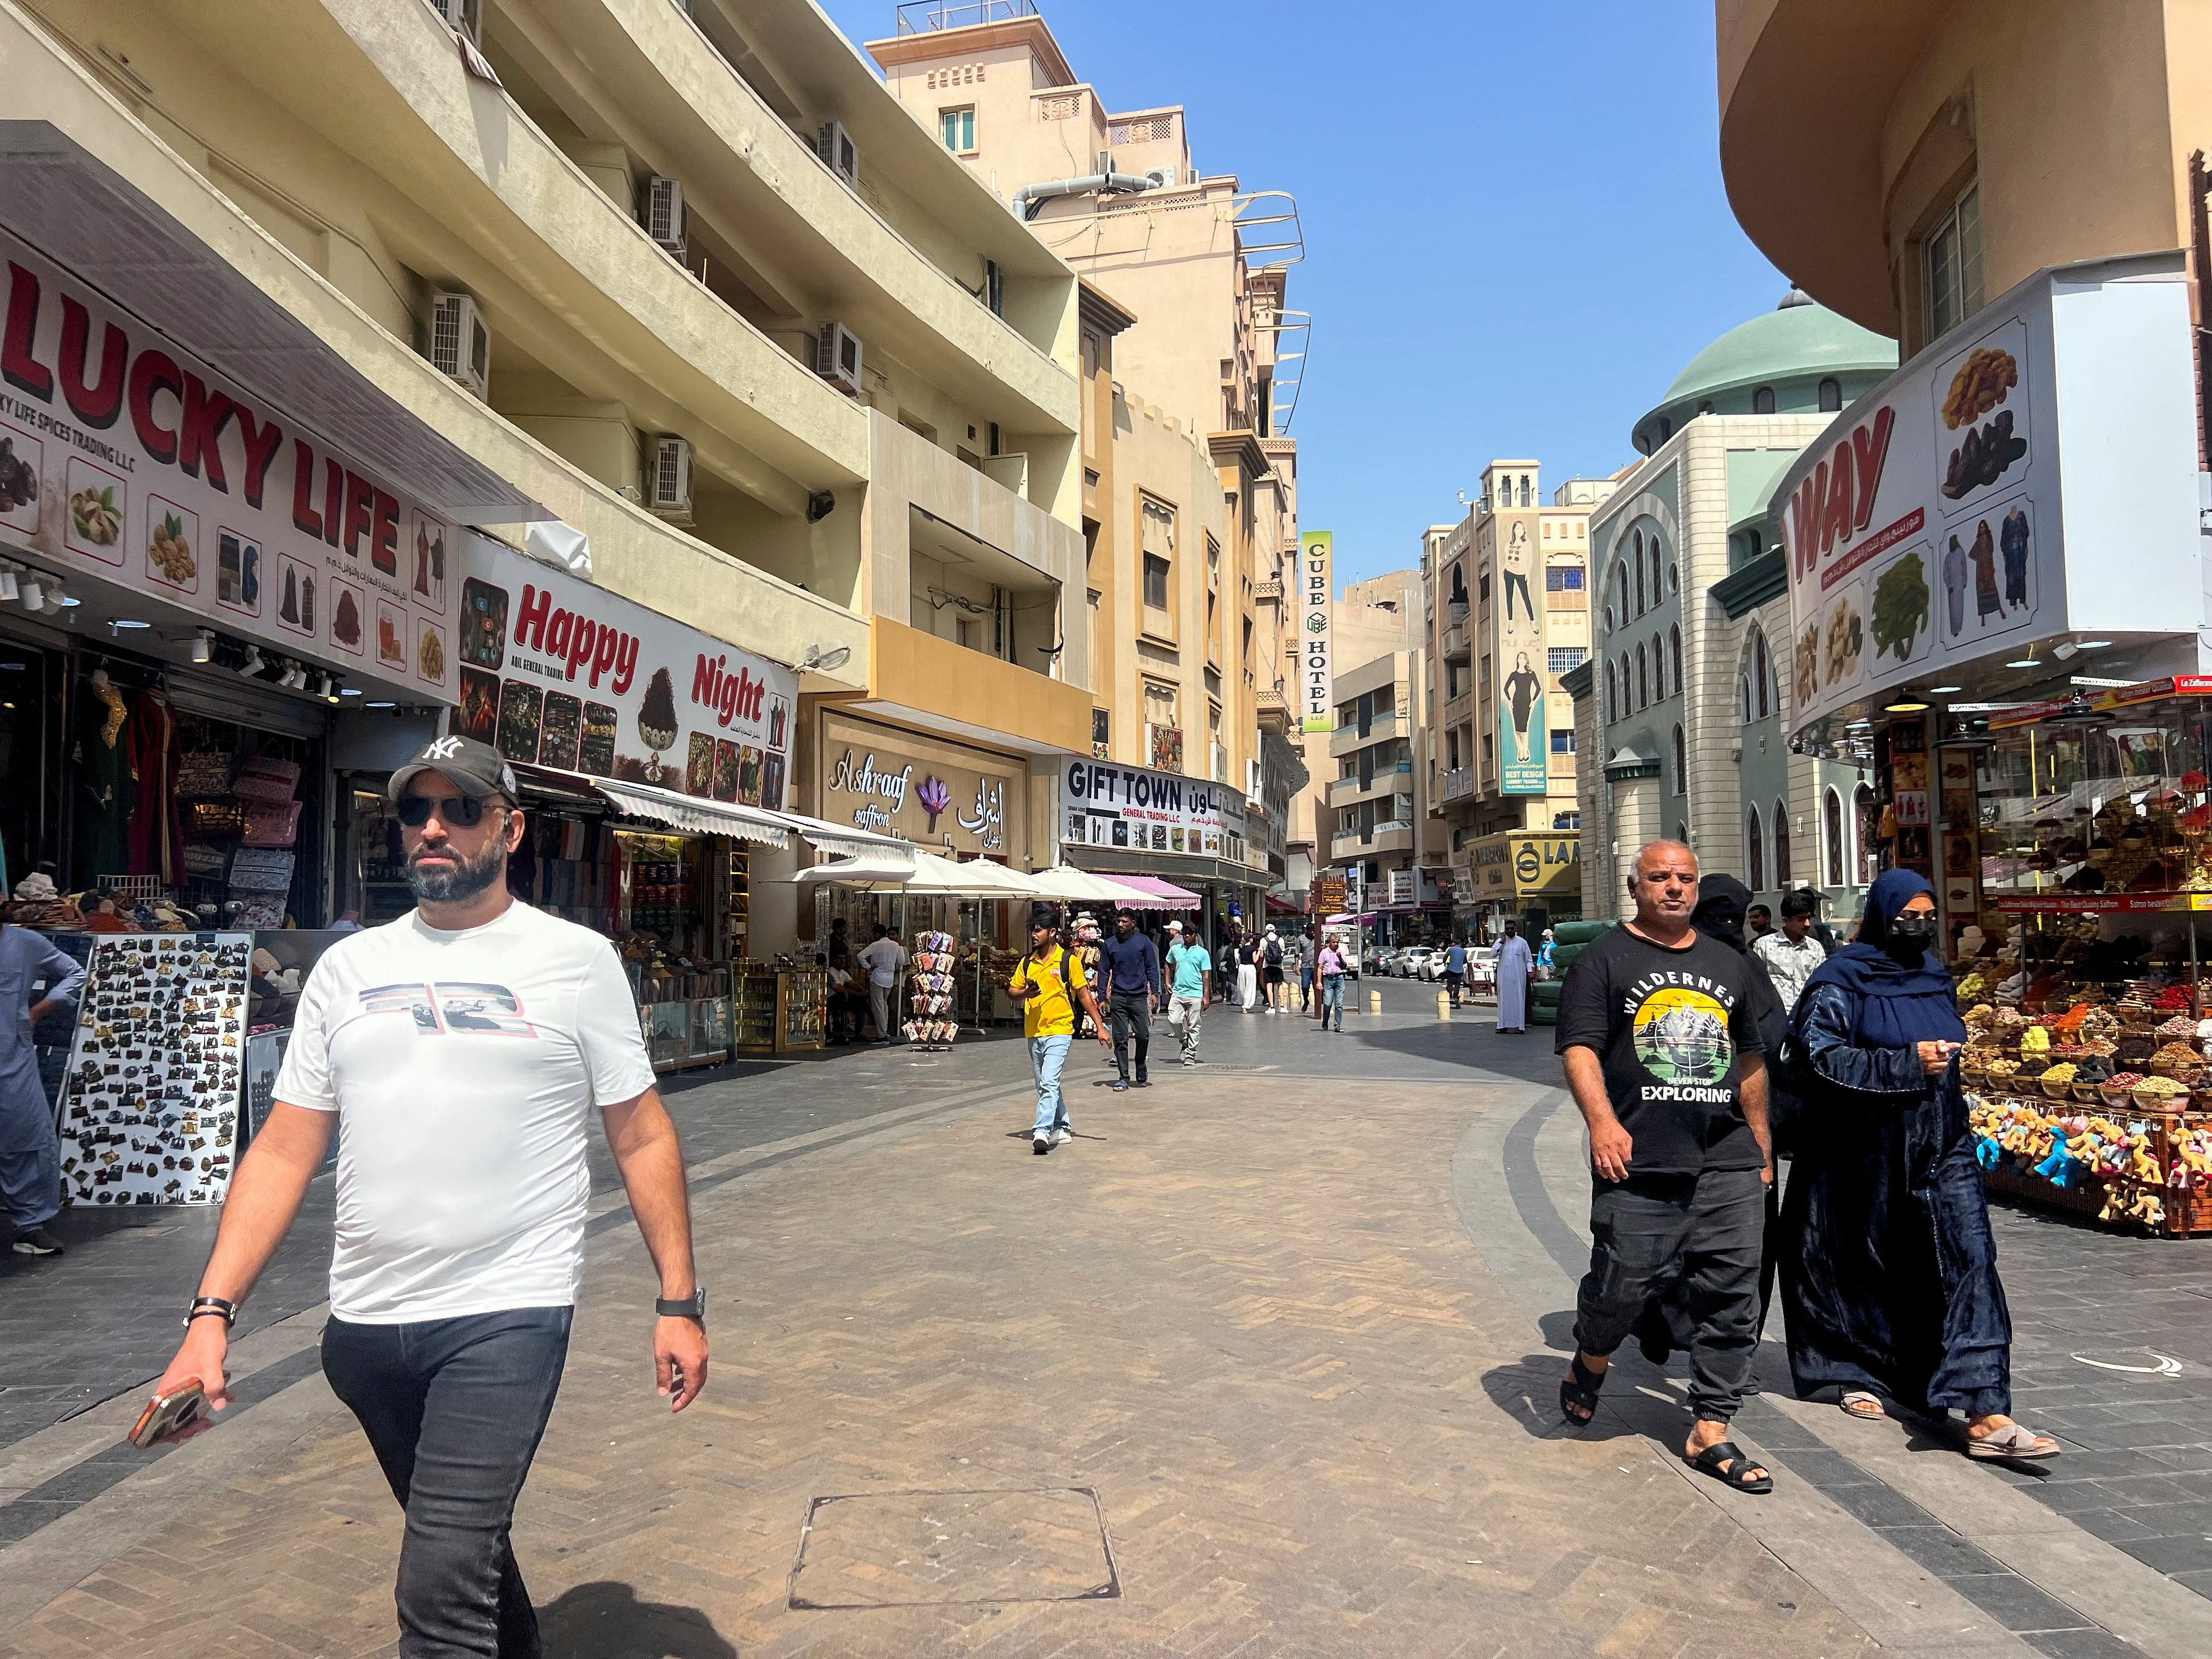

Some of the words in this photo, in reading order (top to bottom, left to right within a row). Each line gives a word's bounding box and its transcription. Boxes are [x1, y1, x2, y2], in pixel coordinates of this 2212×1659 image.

[1, 259, 283, 510] LUCKY
[292, 438, 400, 577] LIFE
[12, 400, 37, 426] LIFE
[37, 411, 71, 443] SPICES
[72, 429, 115, 463] TRADING
[1791, 405, 1895, 585] WAY
[1308, 544, 1325, 605] CUBE
[514, 584, 640, 696] Happy
[523, 658, 543, 675] GENERAL
[544, 665, 563, 680] TRADING
[691, 654, 765, 727] Night
[1308, 641, 1326, 714] HOTEL
[828, 749, 912, 814] Ashraaf
[1068, 761, 1118, 802] GIFT
[1123, 771, 1182, 812] TOWN
[854, 804, 890, 832] saffron
[983, 830, 1002, 849] زعفران
[1122, 807, 1146, 819] GENERAL
[1147, 811, 1169, 822] TRADING
[1623, 970, 1735, 1015] WILDERNES
[1641, 1086, 1733, 1103] EXPLORING
[1667, 1077, 1693, 1085] NEVER
[1694, 1077, 1713, 1086] STOP
